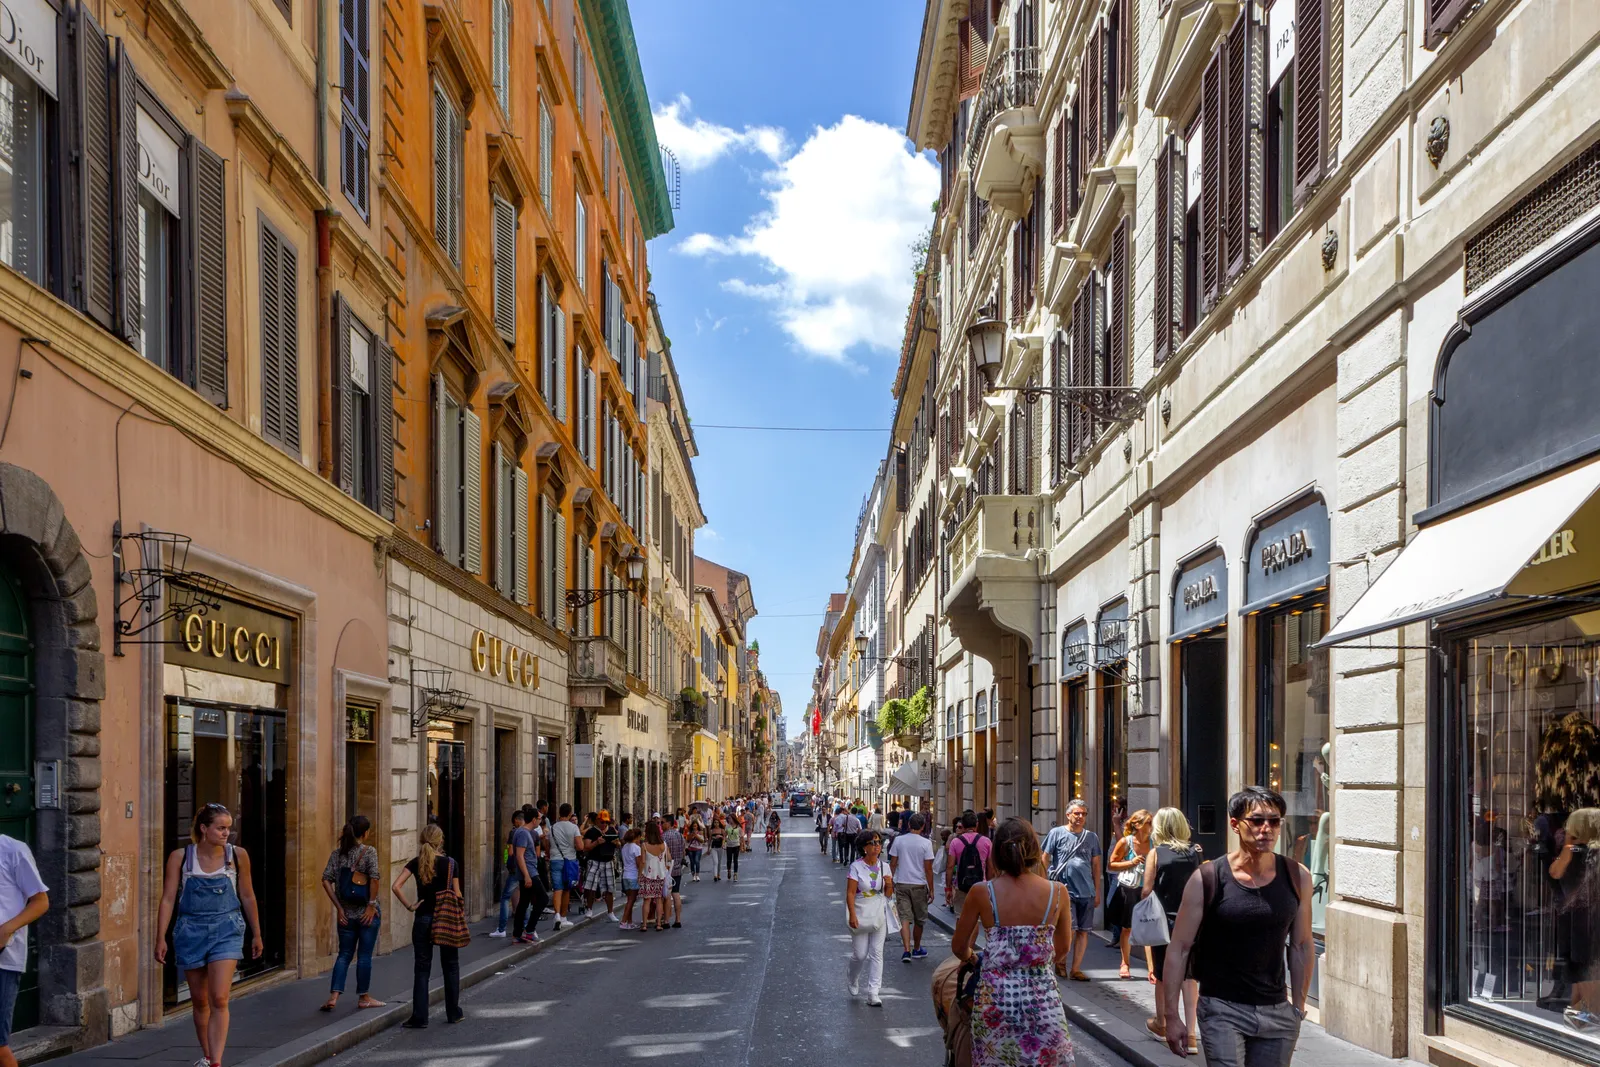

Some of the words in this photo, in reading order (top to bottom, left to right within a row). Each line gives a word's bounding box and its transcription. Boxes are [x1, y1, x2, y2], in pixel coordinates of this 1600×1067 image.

[0, 0, 45, 75] Dior
[137, 142, 171, 200] Dior
[1261, 529, 1314, 570] PRADA
[1183, 575, 1218, 606] PRADA
[181, 613, 280, 670] GUCCI
[470, 629, 540, 691] GUCCI
[626, 707, 649, 734] BVLGARI
